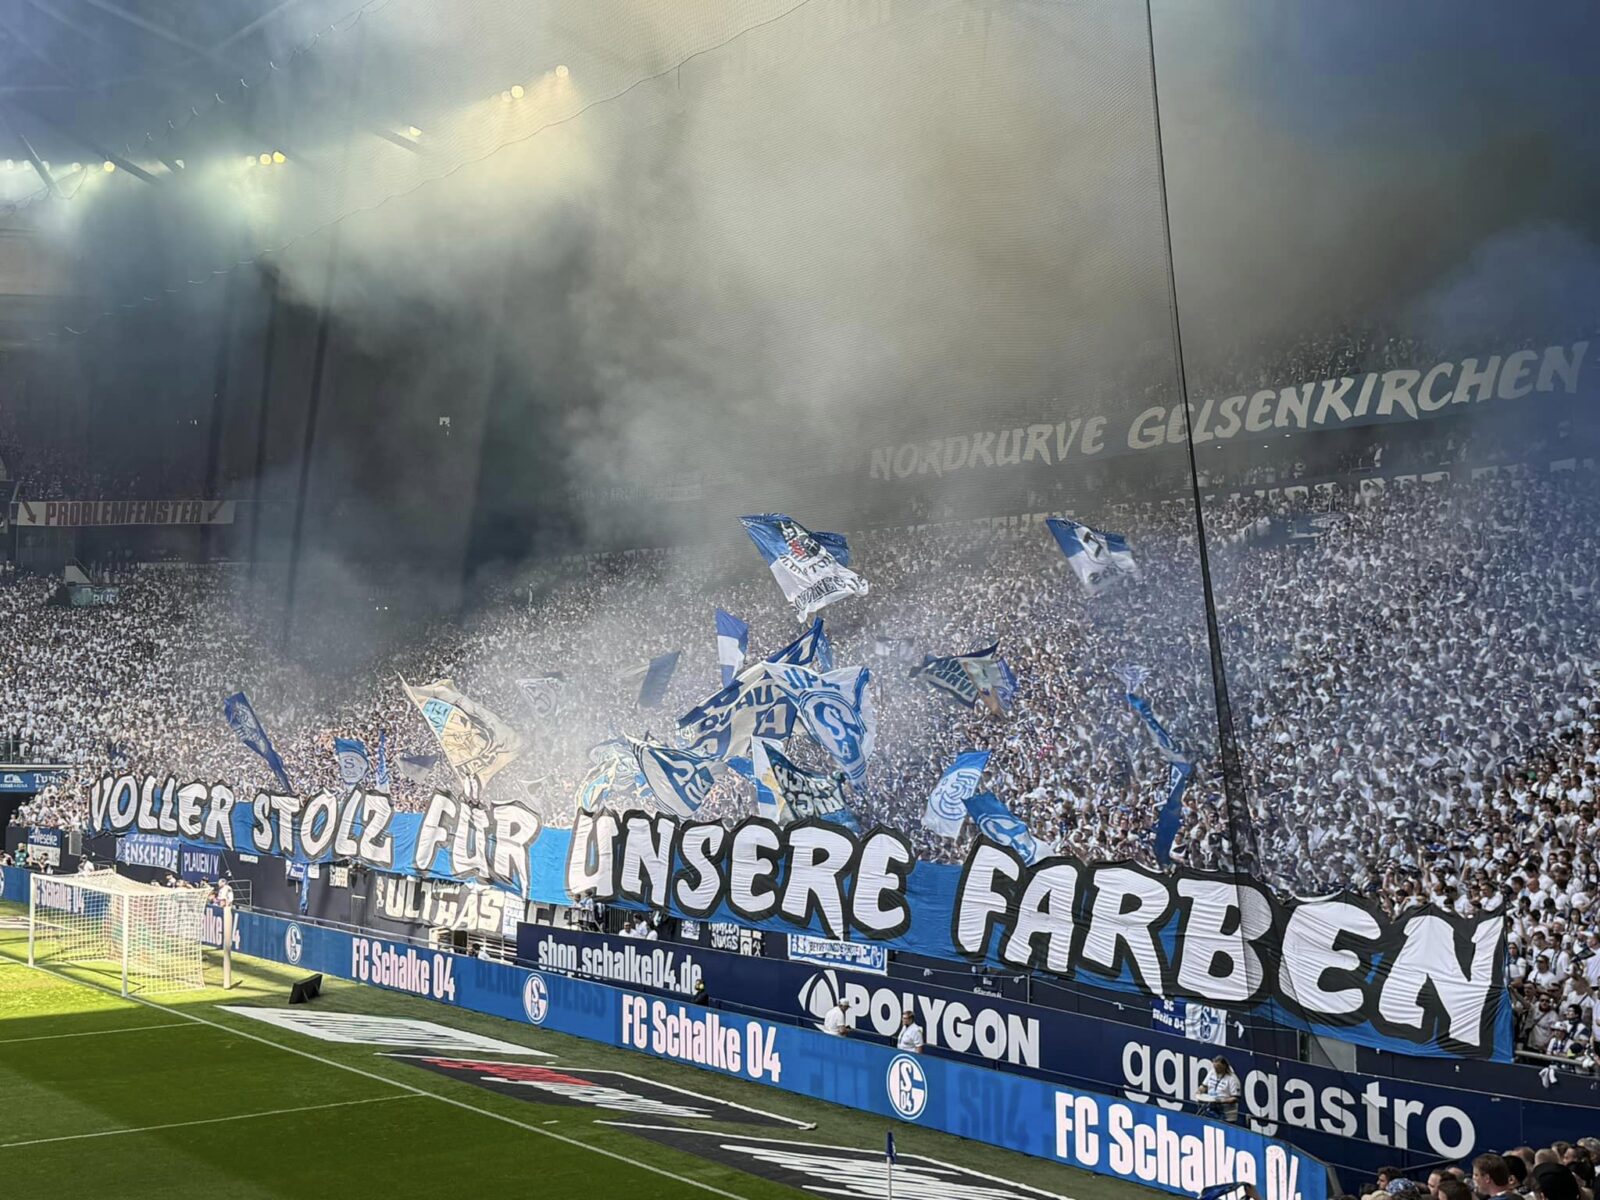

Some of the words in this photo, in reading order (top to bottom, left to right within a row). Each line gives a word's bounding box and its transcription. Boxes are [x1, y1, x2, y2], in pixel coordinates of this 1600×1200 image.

[868, 416, 1108, 481] NORDKURVE
[1127, 341, 1590, 450] GELSENKIRCHEN
[45, 501, 203, 525] PROBLEMFENSTER
[90, 775, 235, 851] VOLLER
[253, 787, 393, 864] STOLZ
[415, 774, 541, 899] FÜR
[566, 813, 910, 942] UNSERE
[957, 844, 1507, 1047] FARBEN
[351, 937, 369, 977] FC
[372, 945, 430, 993] Schalke
[433, 954, 456, 1001] 04
[538, 934, 703, 995] shop.schalke04.de
[621, 994, 648, 1050] FC
[652, 1000, 741, 1073] Schalke
[746, 1021, 781, 1083] 04
[1054, 1090, 1099, 1167] FC
[1244, 1069, 1476, 1159] gastro
